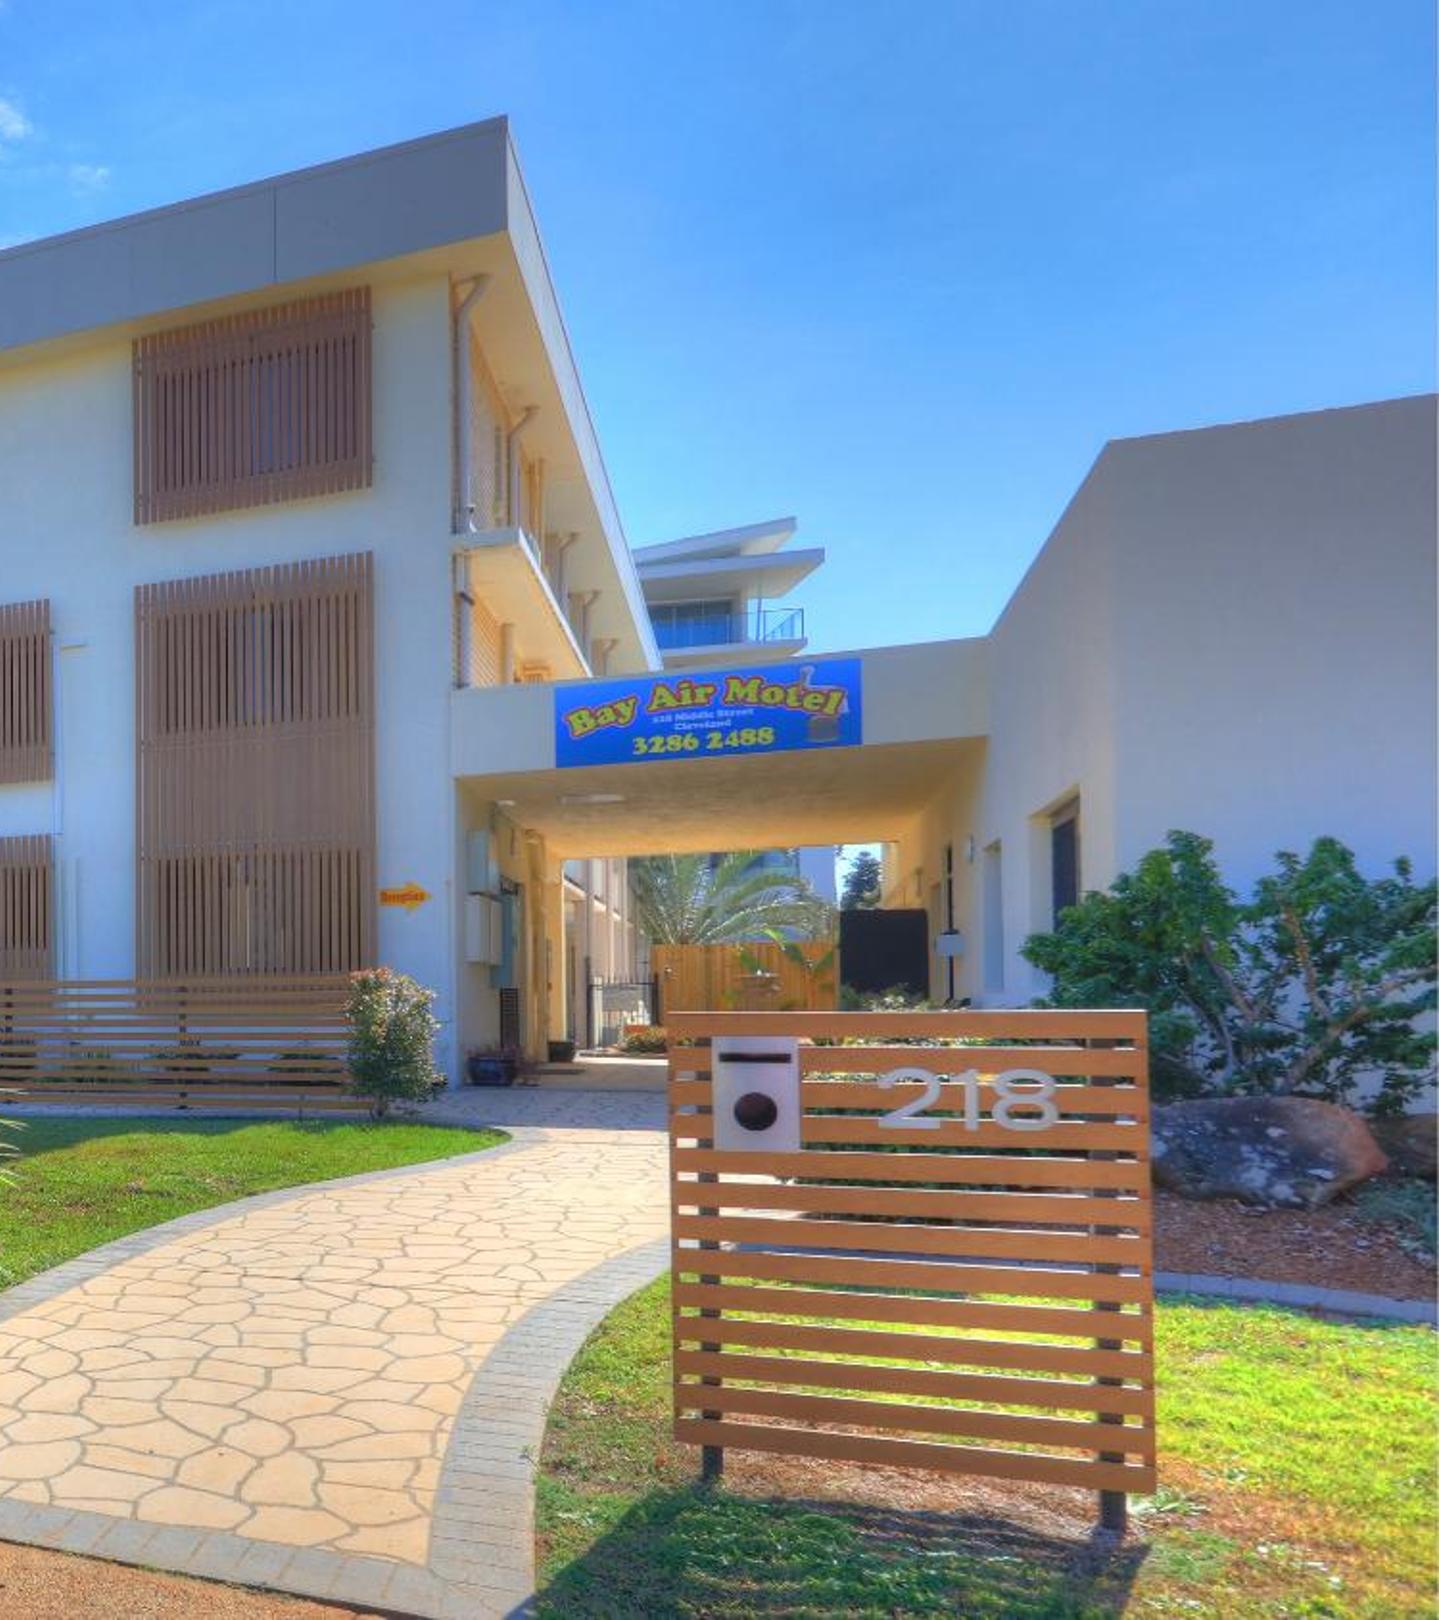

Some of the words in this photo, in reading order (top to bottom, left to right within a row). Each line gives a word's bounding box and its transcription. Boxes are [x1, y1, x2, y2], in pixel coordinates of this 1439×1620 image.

[565, 696, 638, 738] Bay
[646, 679, 716, 712] Air
[723, 676, 845, 717] Motel
[632, 733, 700, 755] 3286
[707, 727, 775, 749] 2488
[878, 1067, 1059, 1131] 218
